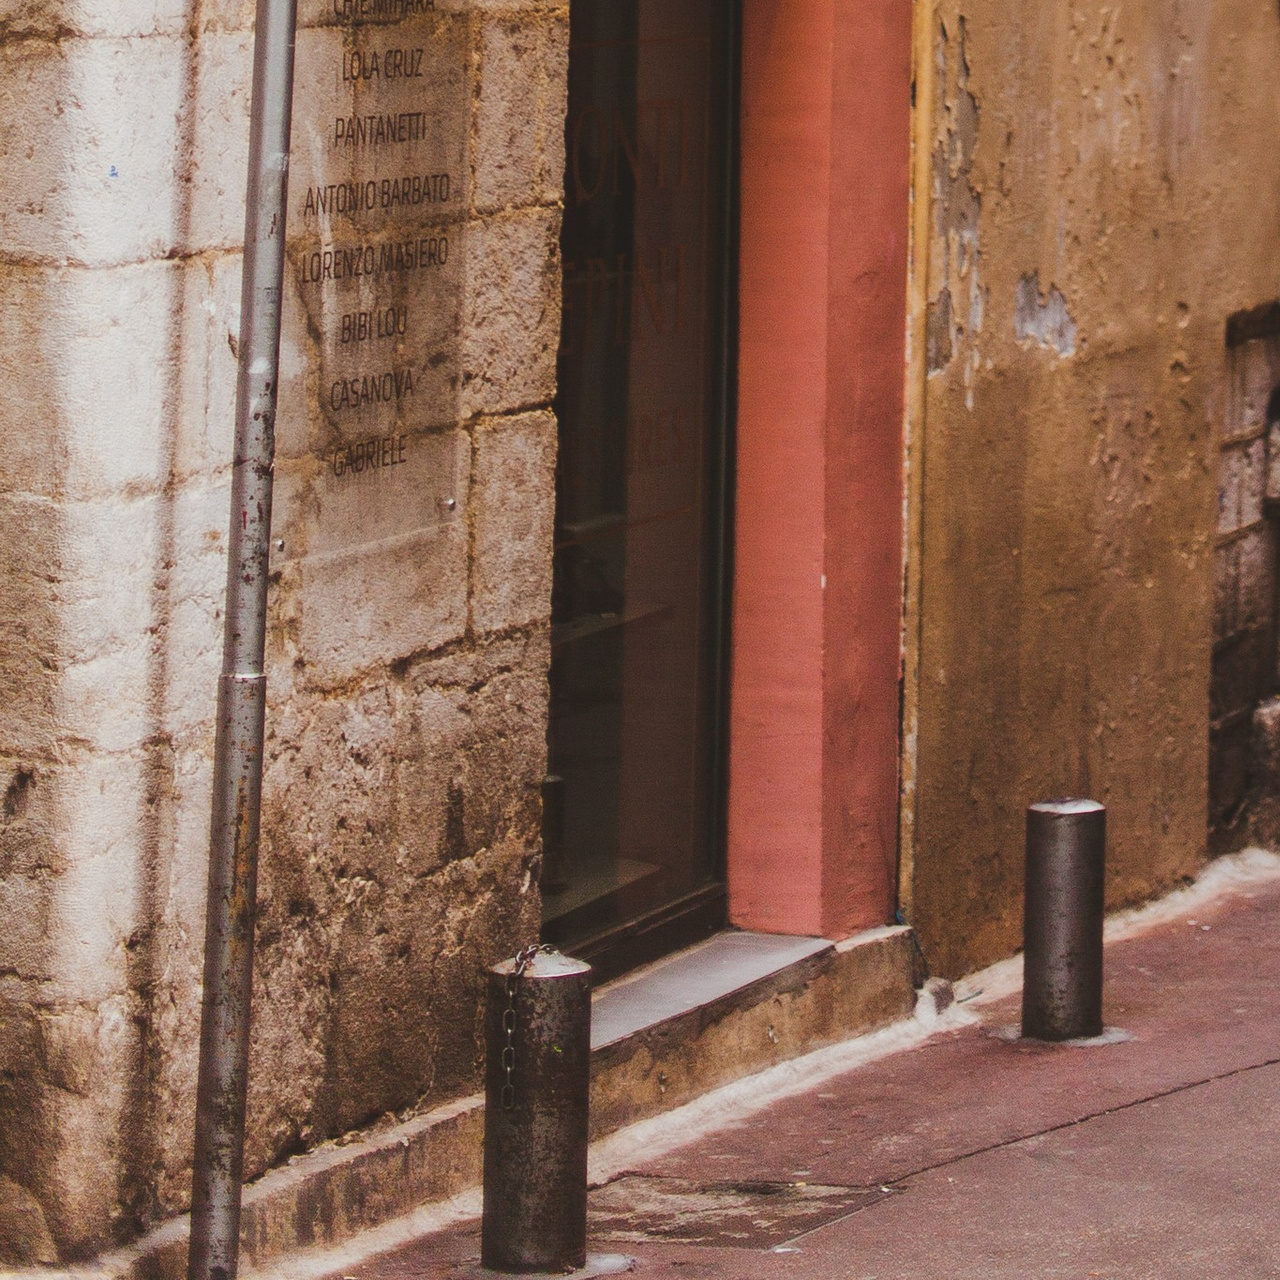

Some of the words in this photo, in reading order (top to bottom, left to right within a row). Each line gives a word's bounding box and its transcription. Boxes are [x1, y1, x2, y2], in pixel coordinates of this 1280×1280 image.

[342, 51, 379, 81] LOLA
[384, 48, 424, 79] CRUZ
[334, 112, 427, 147] PANTANETTI
[303, 180, 377, 216] ANTONIO
[381, 173, 450, 208] BARBATO
[302, 245, 375, 284] LORENZO
[380, 237, 448, 273] MASIERO
[341, 311, 373, 344] BIBI
[377, 305, 408, 338] LOU
[330, 369, 413, 412] CASANOVA
[333, 435, 407, 477] GABRIELE
